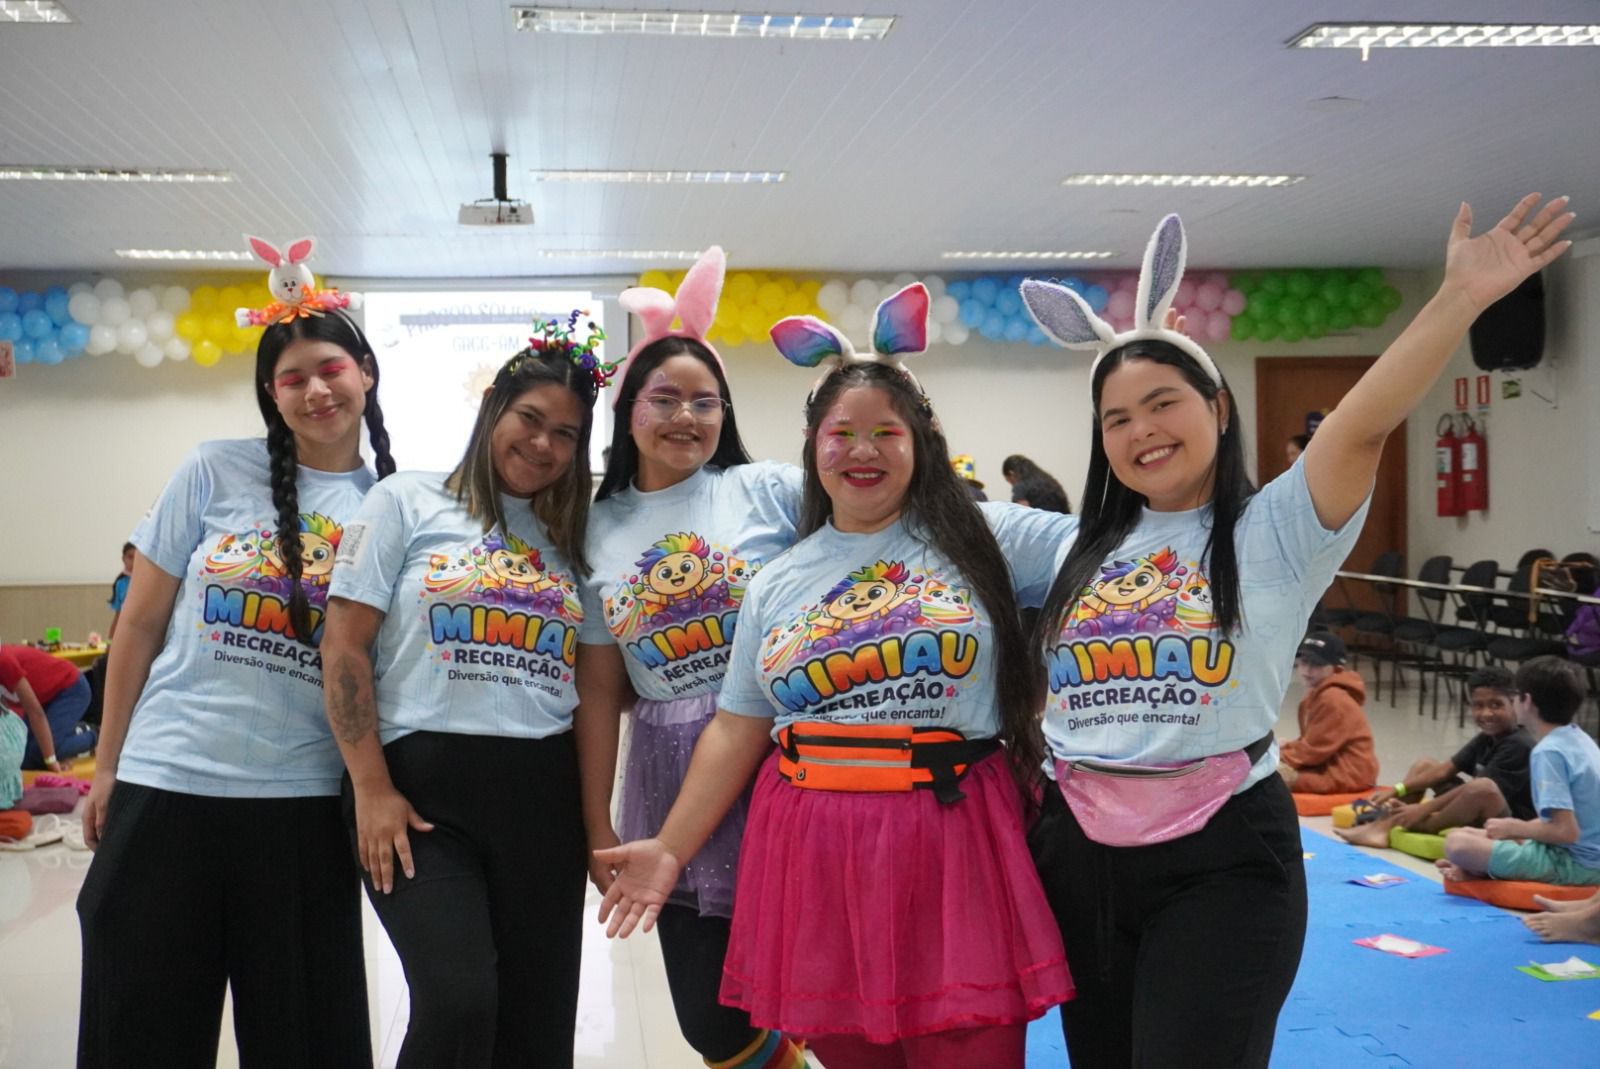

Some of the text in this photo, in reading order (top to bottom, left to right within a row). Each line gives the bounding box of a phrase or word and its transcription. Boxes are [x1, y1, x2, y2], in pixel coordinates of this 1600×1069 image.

[203, 584, 322, 648] MIMI
[223, 631, 323, 671] RECREAÇÃ
[429, 603, 578, 669] MIMIAU
[214, 650, 324, 689] Diversão que encan
[448, 669, 499, 683] Diversão
[502, 675, 523, 687] que
[454, 649, 561, 680] RECREAÇÃO
[770, 630, 978, 712] MIMIAU
[1046, 635, 1235, 694] MIMIAU
[860, 710, 887, 722] que
[890, 706, 946, 720] encanta!
[1068, 683, 1197, 711] RECREAÇÃO
[1068, 712, 1201, 731] Diversão que encanta!
